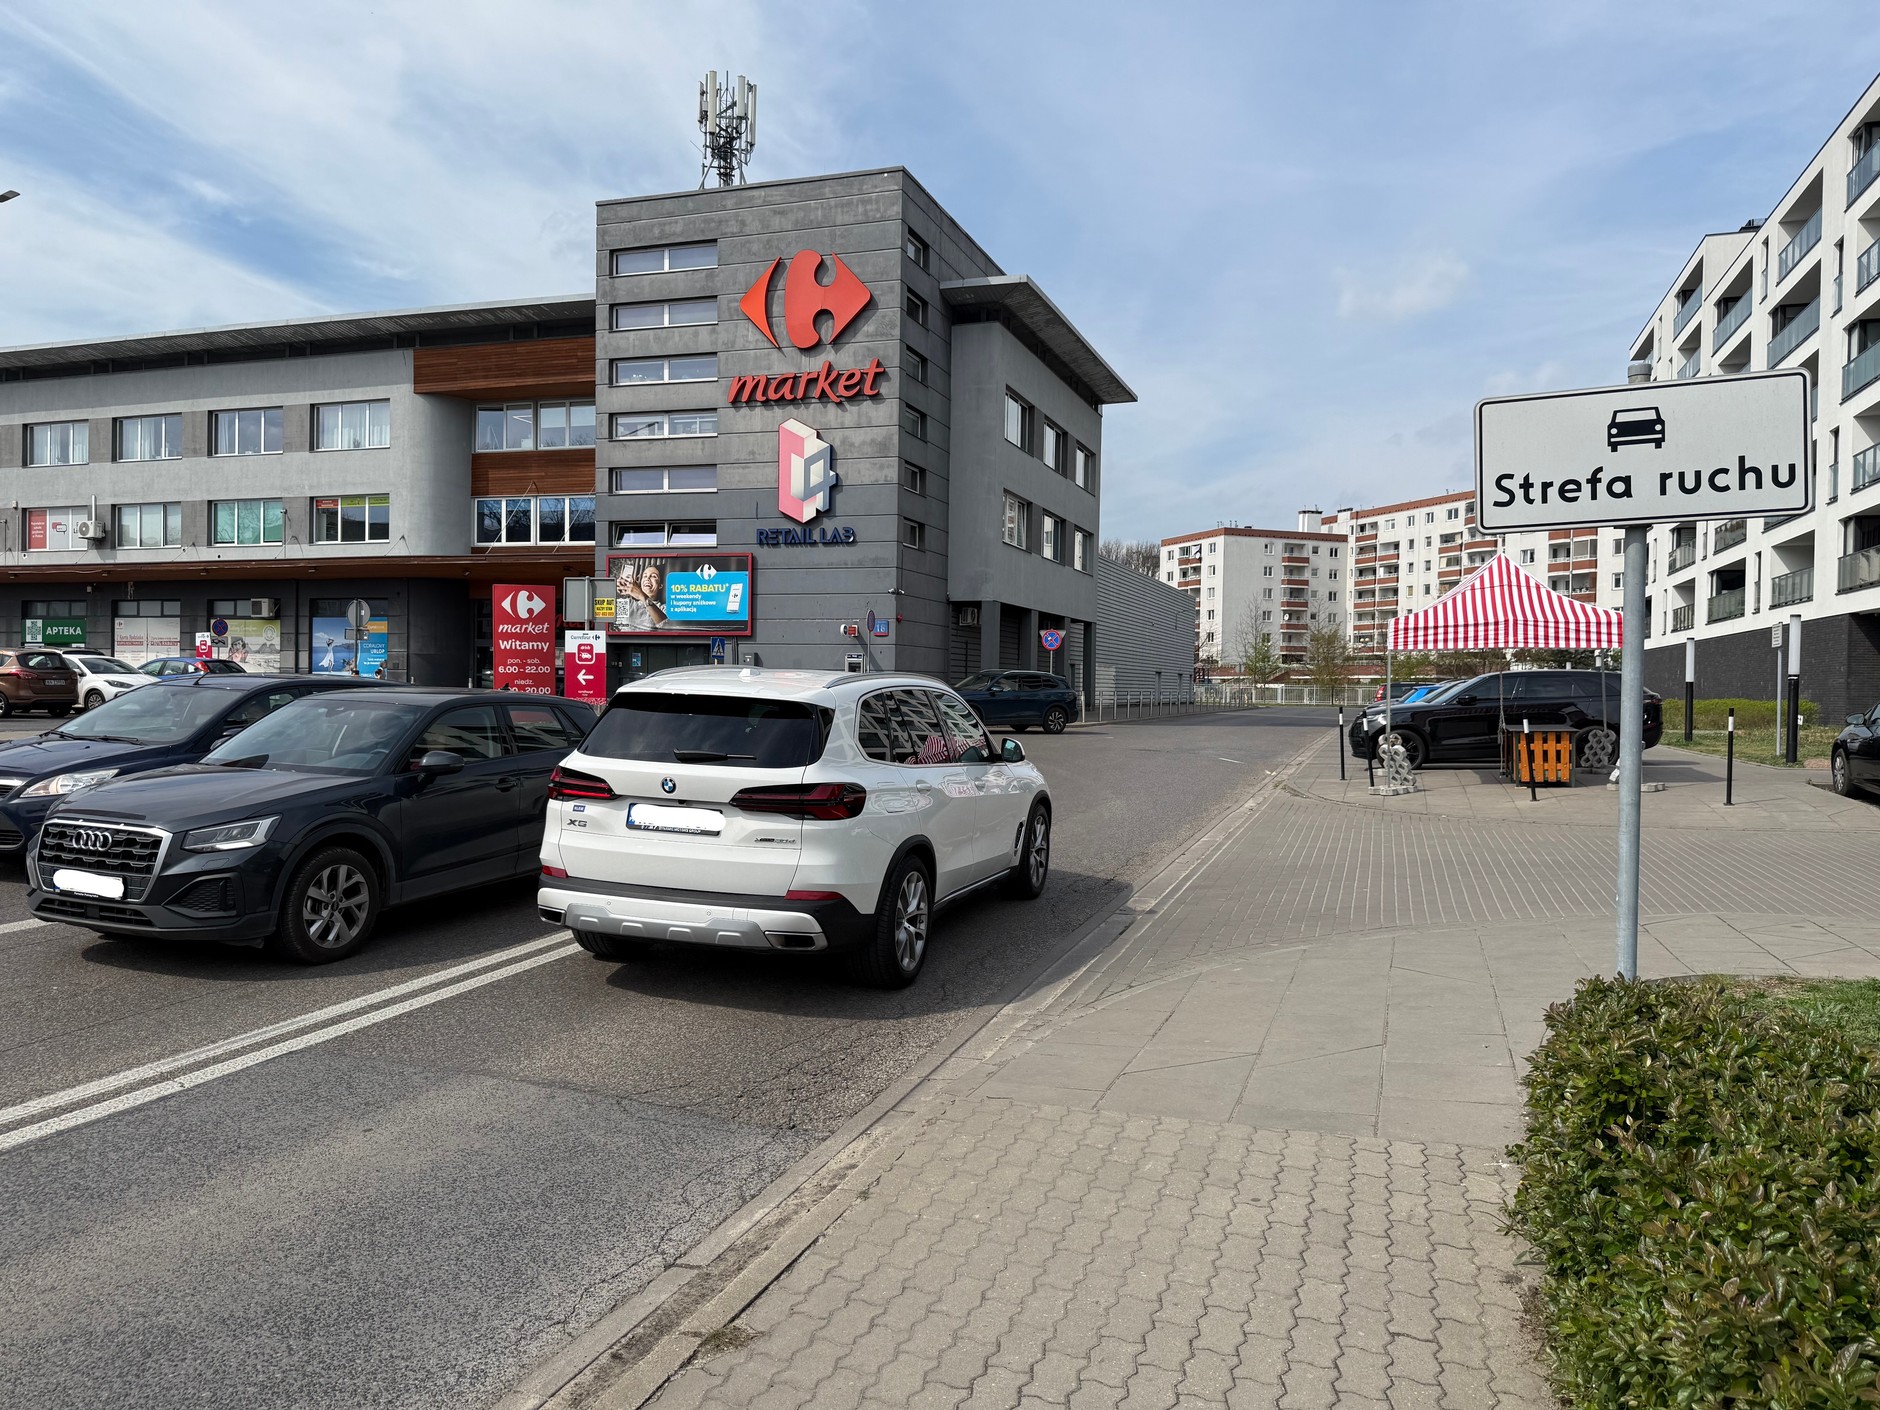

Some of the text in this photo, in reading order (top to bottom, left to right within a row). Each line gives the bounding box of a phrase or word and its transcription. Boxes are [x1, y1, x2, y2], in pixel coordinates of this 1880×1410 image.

[728, 358, 885, 403] market
[1492, 455, 1797, 508] Strefa ruchu
[757, 526, 855, 544] RETAIL LAB
[670, 584, 688, 593] 10%
[45, 626, 82, 635] APTEKA
[498, 622, 549, 634] market
[498, 640, 550, 652] Witamy
[567, 819, 587, 827] X5
